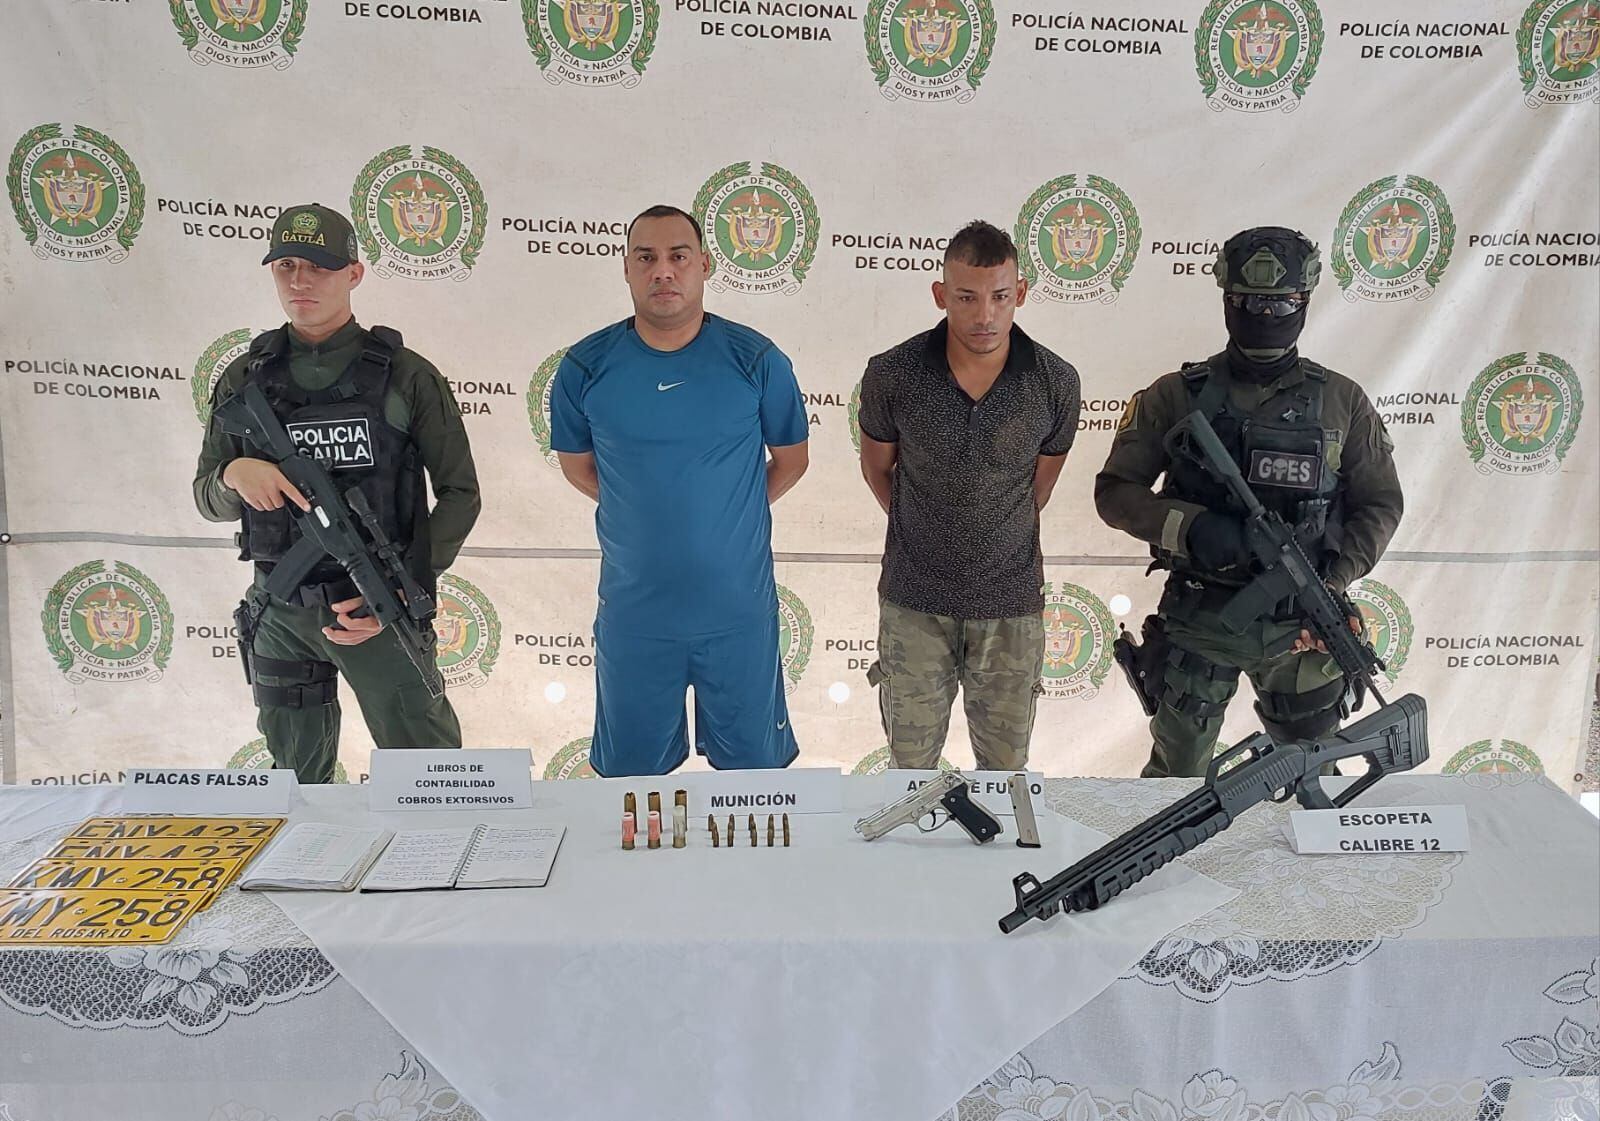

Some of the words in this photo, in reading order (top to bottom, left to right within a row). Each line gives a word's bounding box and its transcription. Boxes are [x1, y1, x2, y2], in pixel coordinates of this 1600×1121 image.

[345, 2, 370, 17] DE
[376, 4, 482, 23] COLOMBIA
[757, 1, 858, 20] NACIONAL
[700, 21, 725, 36] DE
[731, 23, 832, 41] COLOMBIA
[1012, 12, 1085, 30] POLICÍA
[1091, 17, 1188, 33] NACIONAL
[1339, 19, 1410, 37] POLICÍA
[1416, 22, 1510, 37] NACIONAL
[241, 20, 287, 52] NACIONAL
[592, 36, 638, 70] NACIONAL
[1035, 37, 1059, 51] DE
[1064, 39, 1162, 55] COLOMBIA
[1361, 45, 1385, 59] DE
[1389, 44, 1483, 59] COLOMBIA
[242, 50, 278, 65] PATRIA
[592, 69, 627, 84] PATRIA
[928, 55, 974, 86] NACIONAL
[1255, 65, 1300, 97] NACIONAL
[928, 85, 961, 99] PATRIA
[1253, 94, 1287, 109] PATRIA
[62, 139, 79, 149] DE
[91, 148, 129, 205] COLOMBIA
[412, 160, 427, 170] DE
[437, 168, 472, 224] COLOMBIA
[157, 198, 228, 217] POLICÍA
[234, 204, 281, 219] NACI
[750, 177, 764, 186] DE
[774, 184, 804, 238] COLOMBIA
[501, 216, 577, 234] POLICÍA
[583, 221, 628, 236] NACI
[1075, 189, 1089, 197] DE
[1098, 195, 1126, 249] COLOMBIA
[1392, 189, 1405, 197] DE
[1416, 194, 1439, 246] COLOMBIA
[75, 216, 124, 246] NACIONAL
[183, 222, 204, 237] DE
[281, 230, 326, 247] GAULA
[832, 232, 904, 250] POLICÍA
[1152, 238, 1220, 255] POLICÍA
[1468, 229, 1530, 248] POLICÍA
[76, 244, 112, 259] PATRIA
[422, 235, 467, 265] NACIONAL
[527, 240, 552, 254] DE
[557, 241, 626, 257] COLOM
[755, 248, 799, 279] NACIONAL
[855, 256, 878, 270] DE
[1173, 262, 1196, 275] DE
[1484, 253, 1505, 267] DE
[422, 263, 456, 278] PATRIA
[1074, 258, 1119, 289] NACIONAL
[1386, 257, 1433, 287] NACIONAL
[754, 278, 787, 291] PATRIA
[1385, 284, 1420, 299] PATRIA
[1073, 286, 1105, 301] PATRIA
[5, 358, 79, 375] POLICÍA
[83, 364, 186, 381] NACIONAL
[33, 381, 60, 395] DE
[64, 383, 161, 400] COLOMBIA
[1525, 366, 1540, 374] DE
[1549, 371, 1571, 421] COLOMBIA
[1376, 392, 1460, 409] NACIONAL
[1381, 412, 1435, 425] OMBIA
[291, 425, 367, 446] POLICIA
[1523, 431, 1562, 461] NACIONAL
[1521, 458, 1551, 473] PATRIA
[106, 573, 119, 581] DE
[129, 582, 160, 631] COLOMBIA
[456, 591, 487, 637] COLOMBIA
[1052, 595, 1065, 603] DE
[1075, 602, 1102, 649] COLOMBIA
[1371, 597, 1398, 645] COLOMBIA
[186, 626, 240, 638] POLIC
[515, 632, 585, 648] POLICÍA
[825, 639, 875, 651] POLIC
[1425, 634, 1491, 650] POLICÍA
[1495, 635, 1584, 648] NACIONAL
[117, 640, 158, 668] NACIONAL
[212, 646, 237, 658] DE
[539, 653, 561, 666] DE
[1447, 656, 1469, 668] DE
[1473, 653, 1560, 667] COLOMBIA
[442, 648, 484, 675] NACIONAL
[847, 658, 869, 670] DE
[117, 666, 150, 680] PATRIA
[1055, 656, 1098, 686] NACIONAL
[1054, 684, 1087, 697] PATRIA
[427, 764, 467, 773] LIBROS
[470, 764, 484, 773] DE
[134, 772, 200, 786] PLACAS
[206, 774, 269, 786] FALSAS
[415, 780, 496, 788] CONTABILIDAD
[986, 782, 1042, 795] FUO
[397, 796, 442, 805] COBROS
[445, 796, 514, 804] EXTORSIVOS
[711, 791, 796, 807] MUNICIÓN
[1339, 812, 1432, 826] ESCOPETA
[1339, 839, 1414, 851] CALIBRE
[1420, 839, 1440, 851] 12
[10, 929, 42, 938] DEL
[49, 929, 133, 938] ROSARIO
